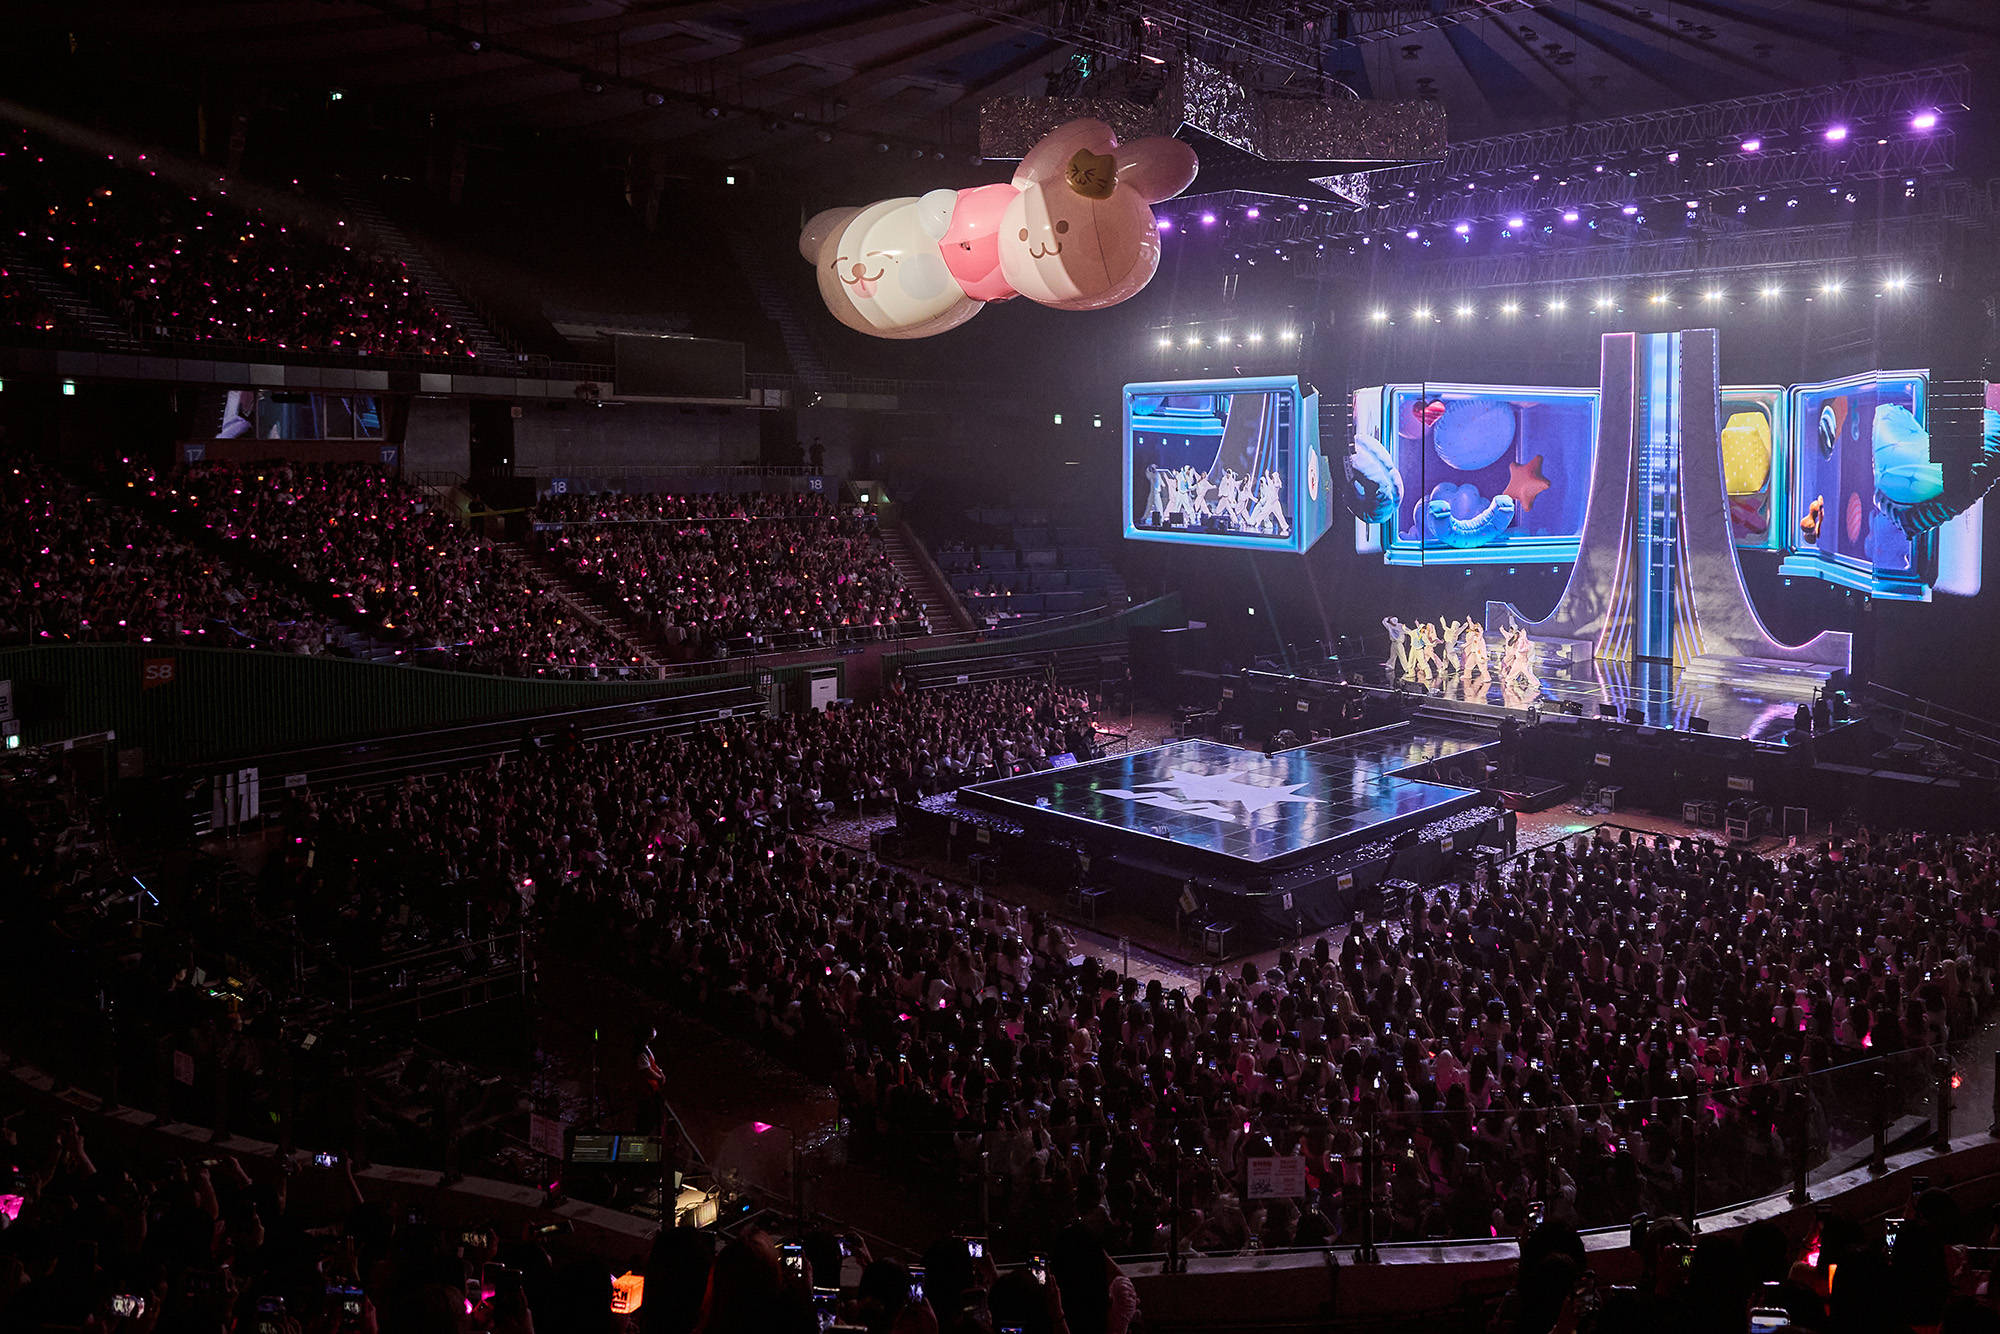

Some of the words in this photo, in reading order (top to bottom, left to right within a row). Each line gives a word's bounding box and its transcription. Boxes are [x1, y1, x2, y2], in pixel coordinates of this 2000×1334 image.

[381, 450, 396, 464] 17
[552, 481, 567, 494] 18
[809, 479, 822, 490] 18
[145, 664, 173, 680] S8
